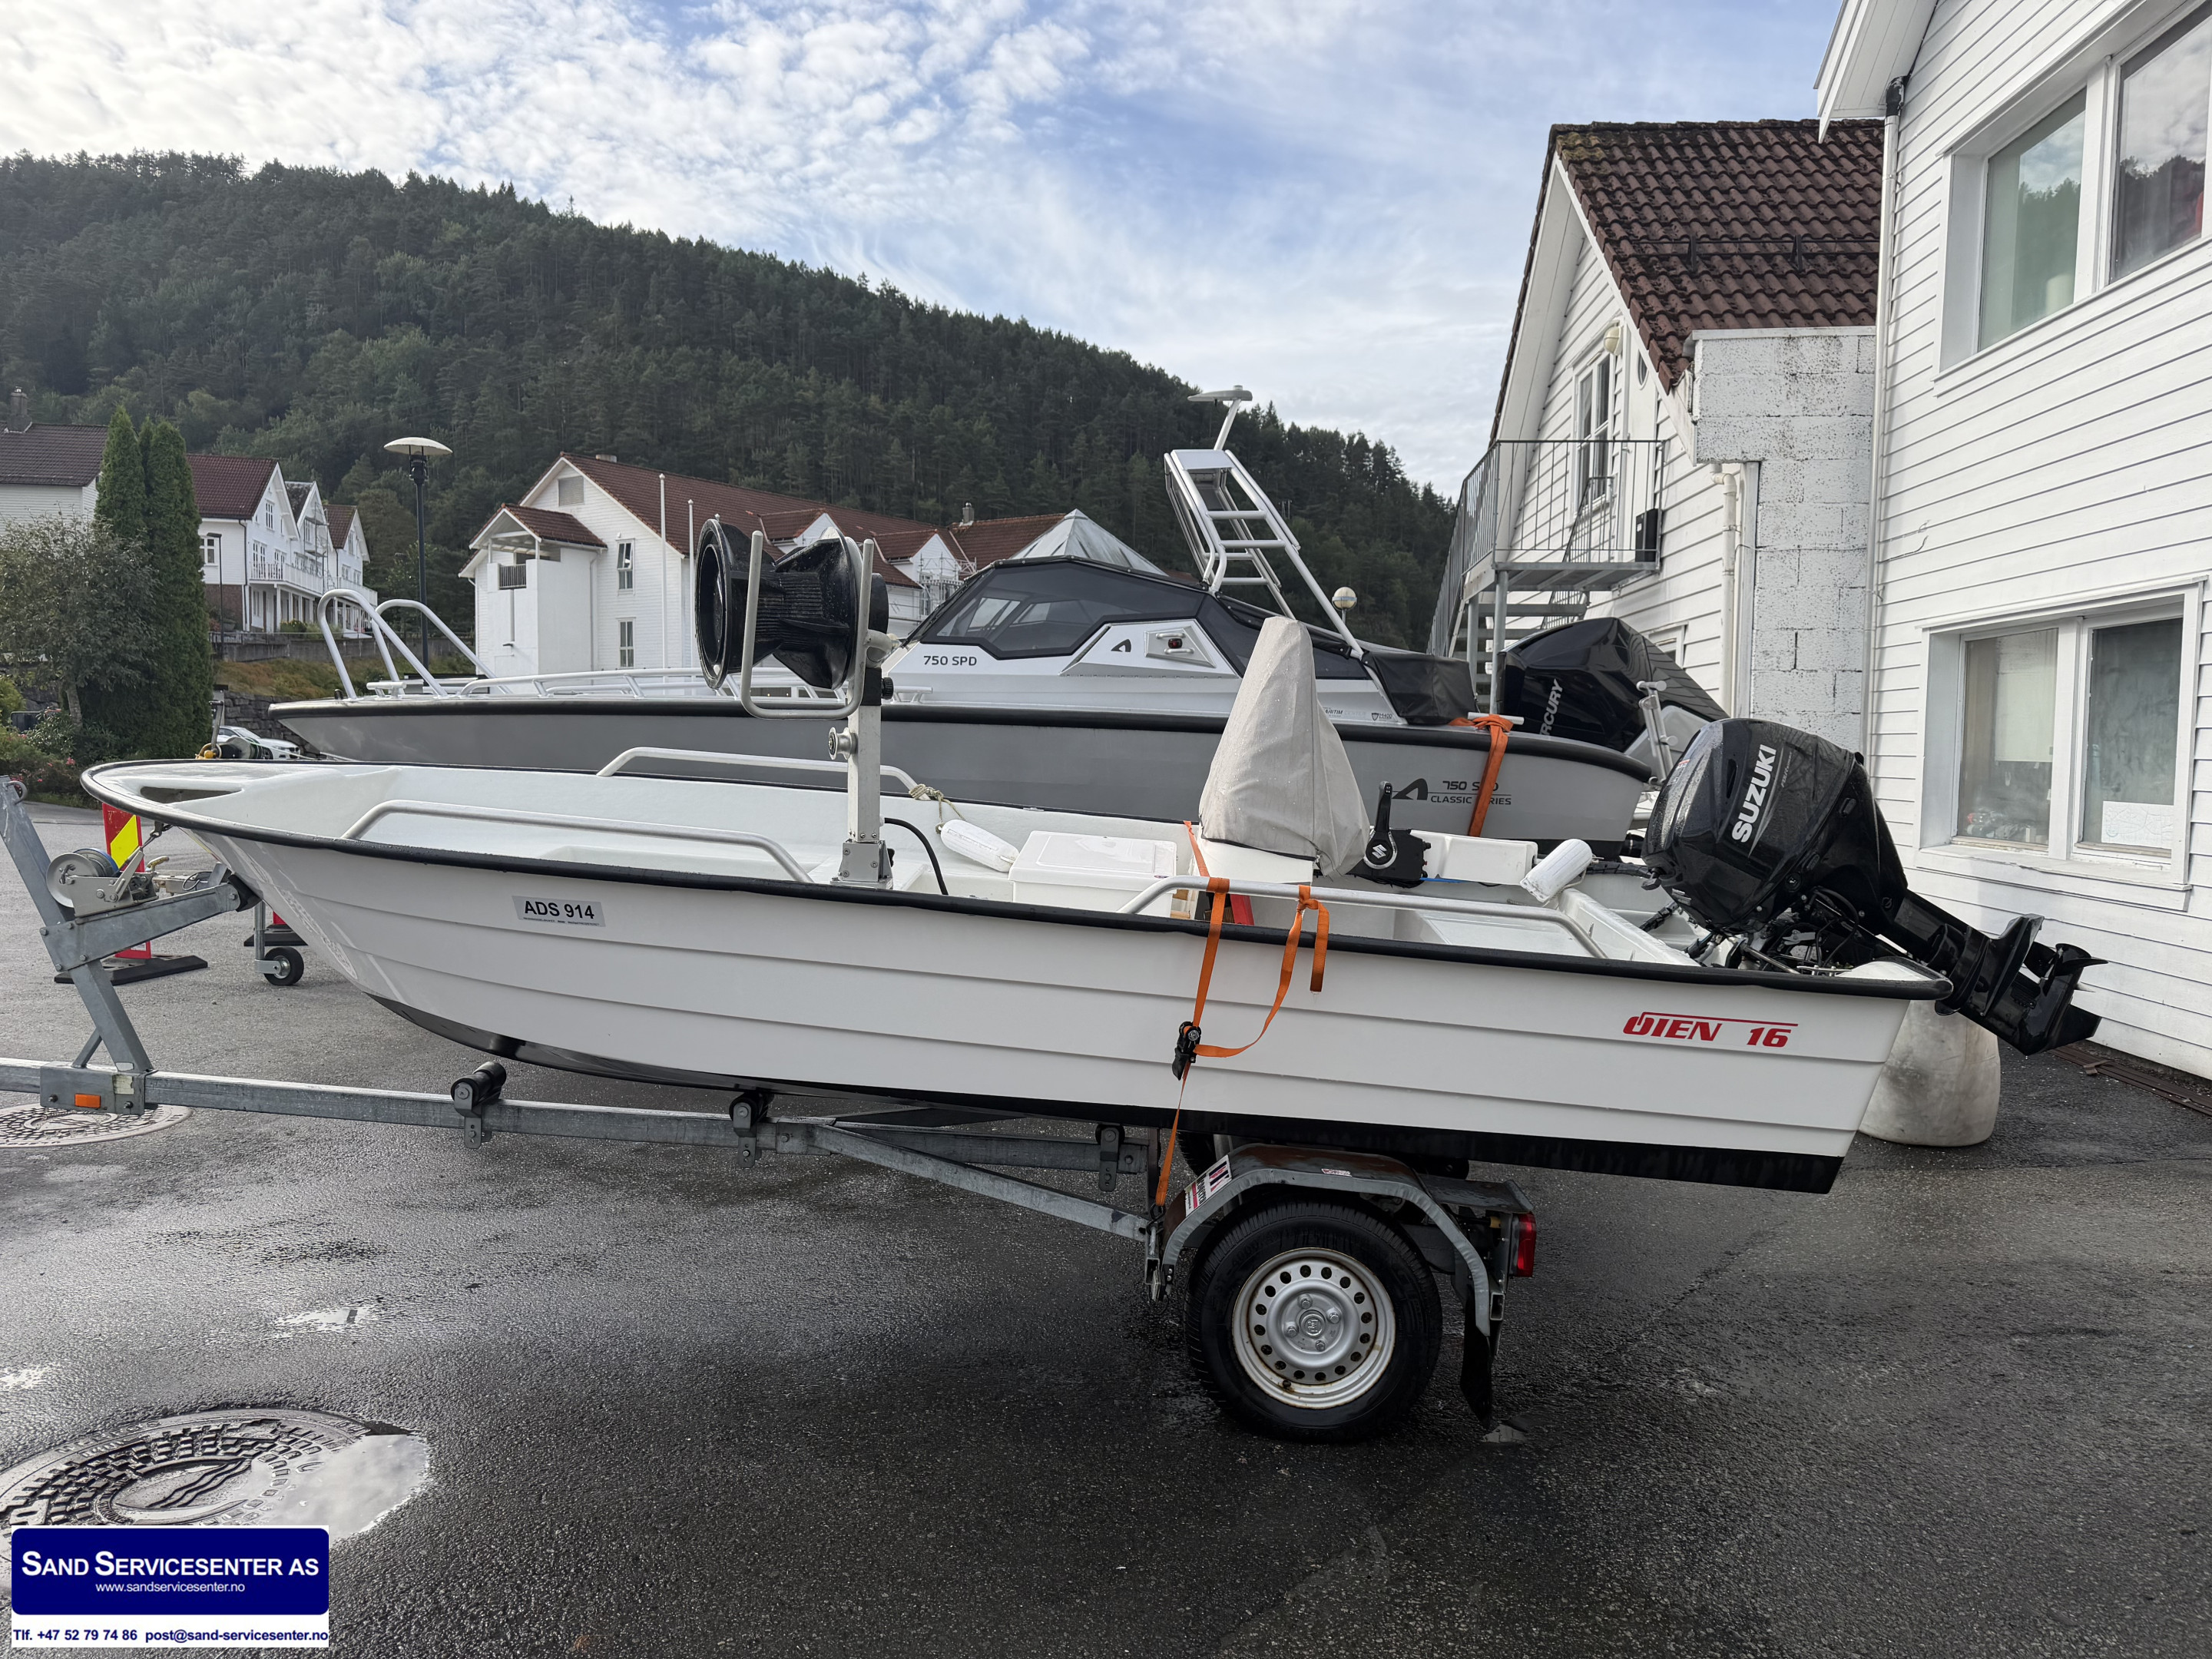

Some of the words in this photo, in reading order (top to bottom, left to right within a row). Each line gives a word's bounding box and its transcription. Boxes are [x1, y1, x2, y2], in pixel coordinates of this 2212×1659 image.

[923, 655, 949, 665] 750
[952, 656, 977, 666] SPD
[1539, 678, 1563, 736] RCURY
[1442, 780, 1468, 790] 750
[1472, 782, 1499, 792] SD
[1732, 744, 1777, 843] SUZUKI
[1430, 795, 1472, 804] CLASSIC
[1488, 796, 1512, 805] RIES
[525, 900, 560, 917] ADS
[564, 903, 595, 919] 914
[1746, 1027, 1792, 1048] 16
